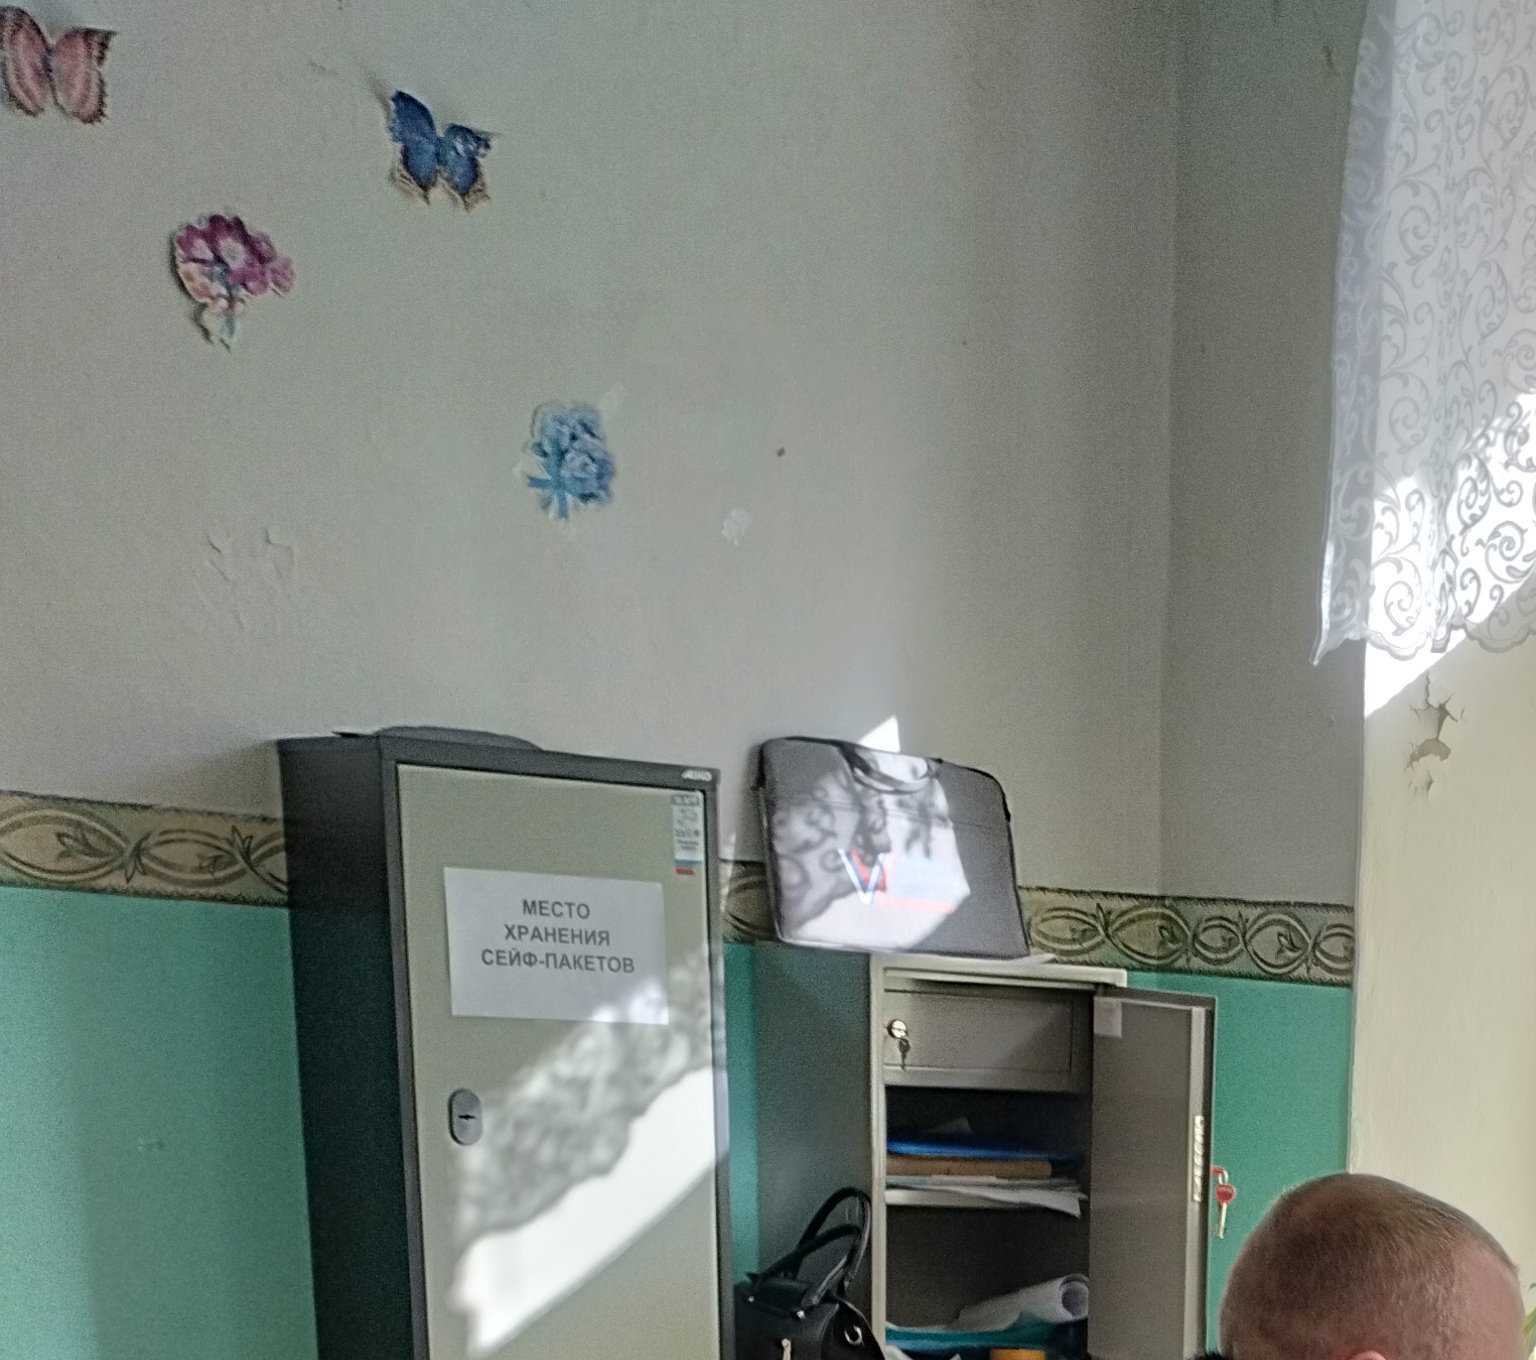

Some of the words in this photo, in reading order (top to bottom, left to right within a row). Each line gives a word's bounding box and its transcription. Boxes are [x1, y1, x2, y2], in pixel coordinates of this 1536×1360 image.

[522, 899, 591, 919] МЕСТО
[504, 924, 610, 946] ХРАНЕНИЯ
[481, 947, 635, 973] СЕЙФ-ПАКЕТОВ
